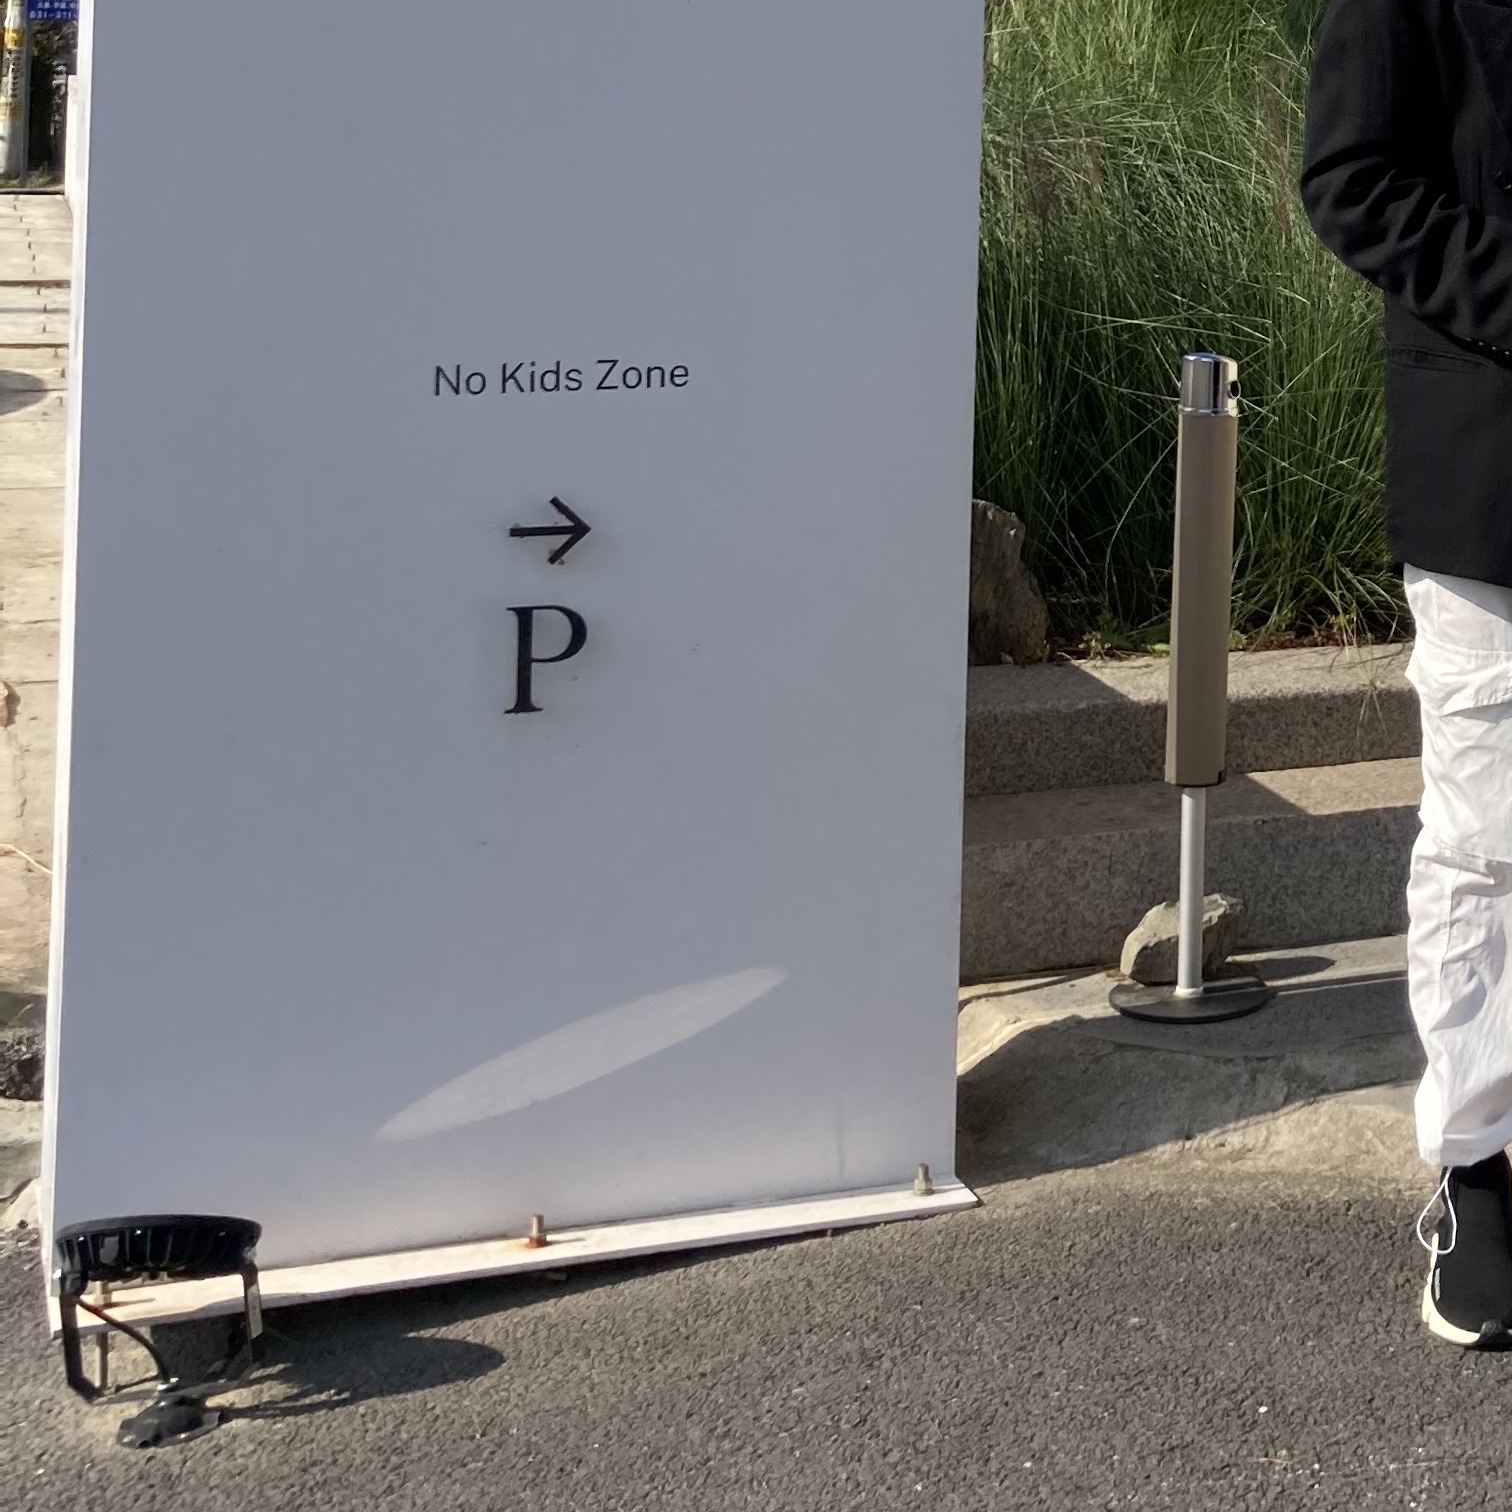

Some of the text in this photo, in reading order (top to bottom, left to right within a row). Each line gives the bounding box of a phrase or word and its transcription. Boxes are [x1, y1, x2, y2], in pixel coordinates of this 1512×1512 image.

[434, 359, 689, 396] No Kids Zone
[504, 604, 588, 714] P
